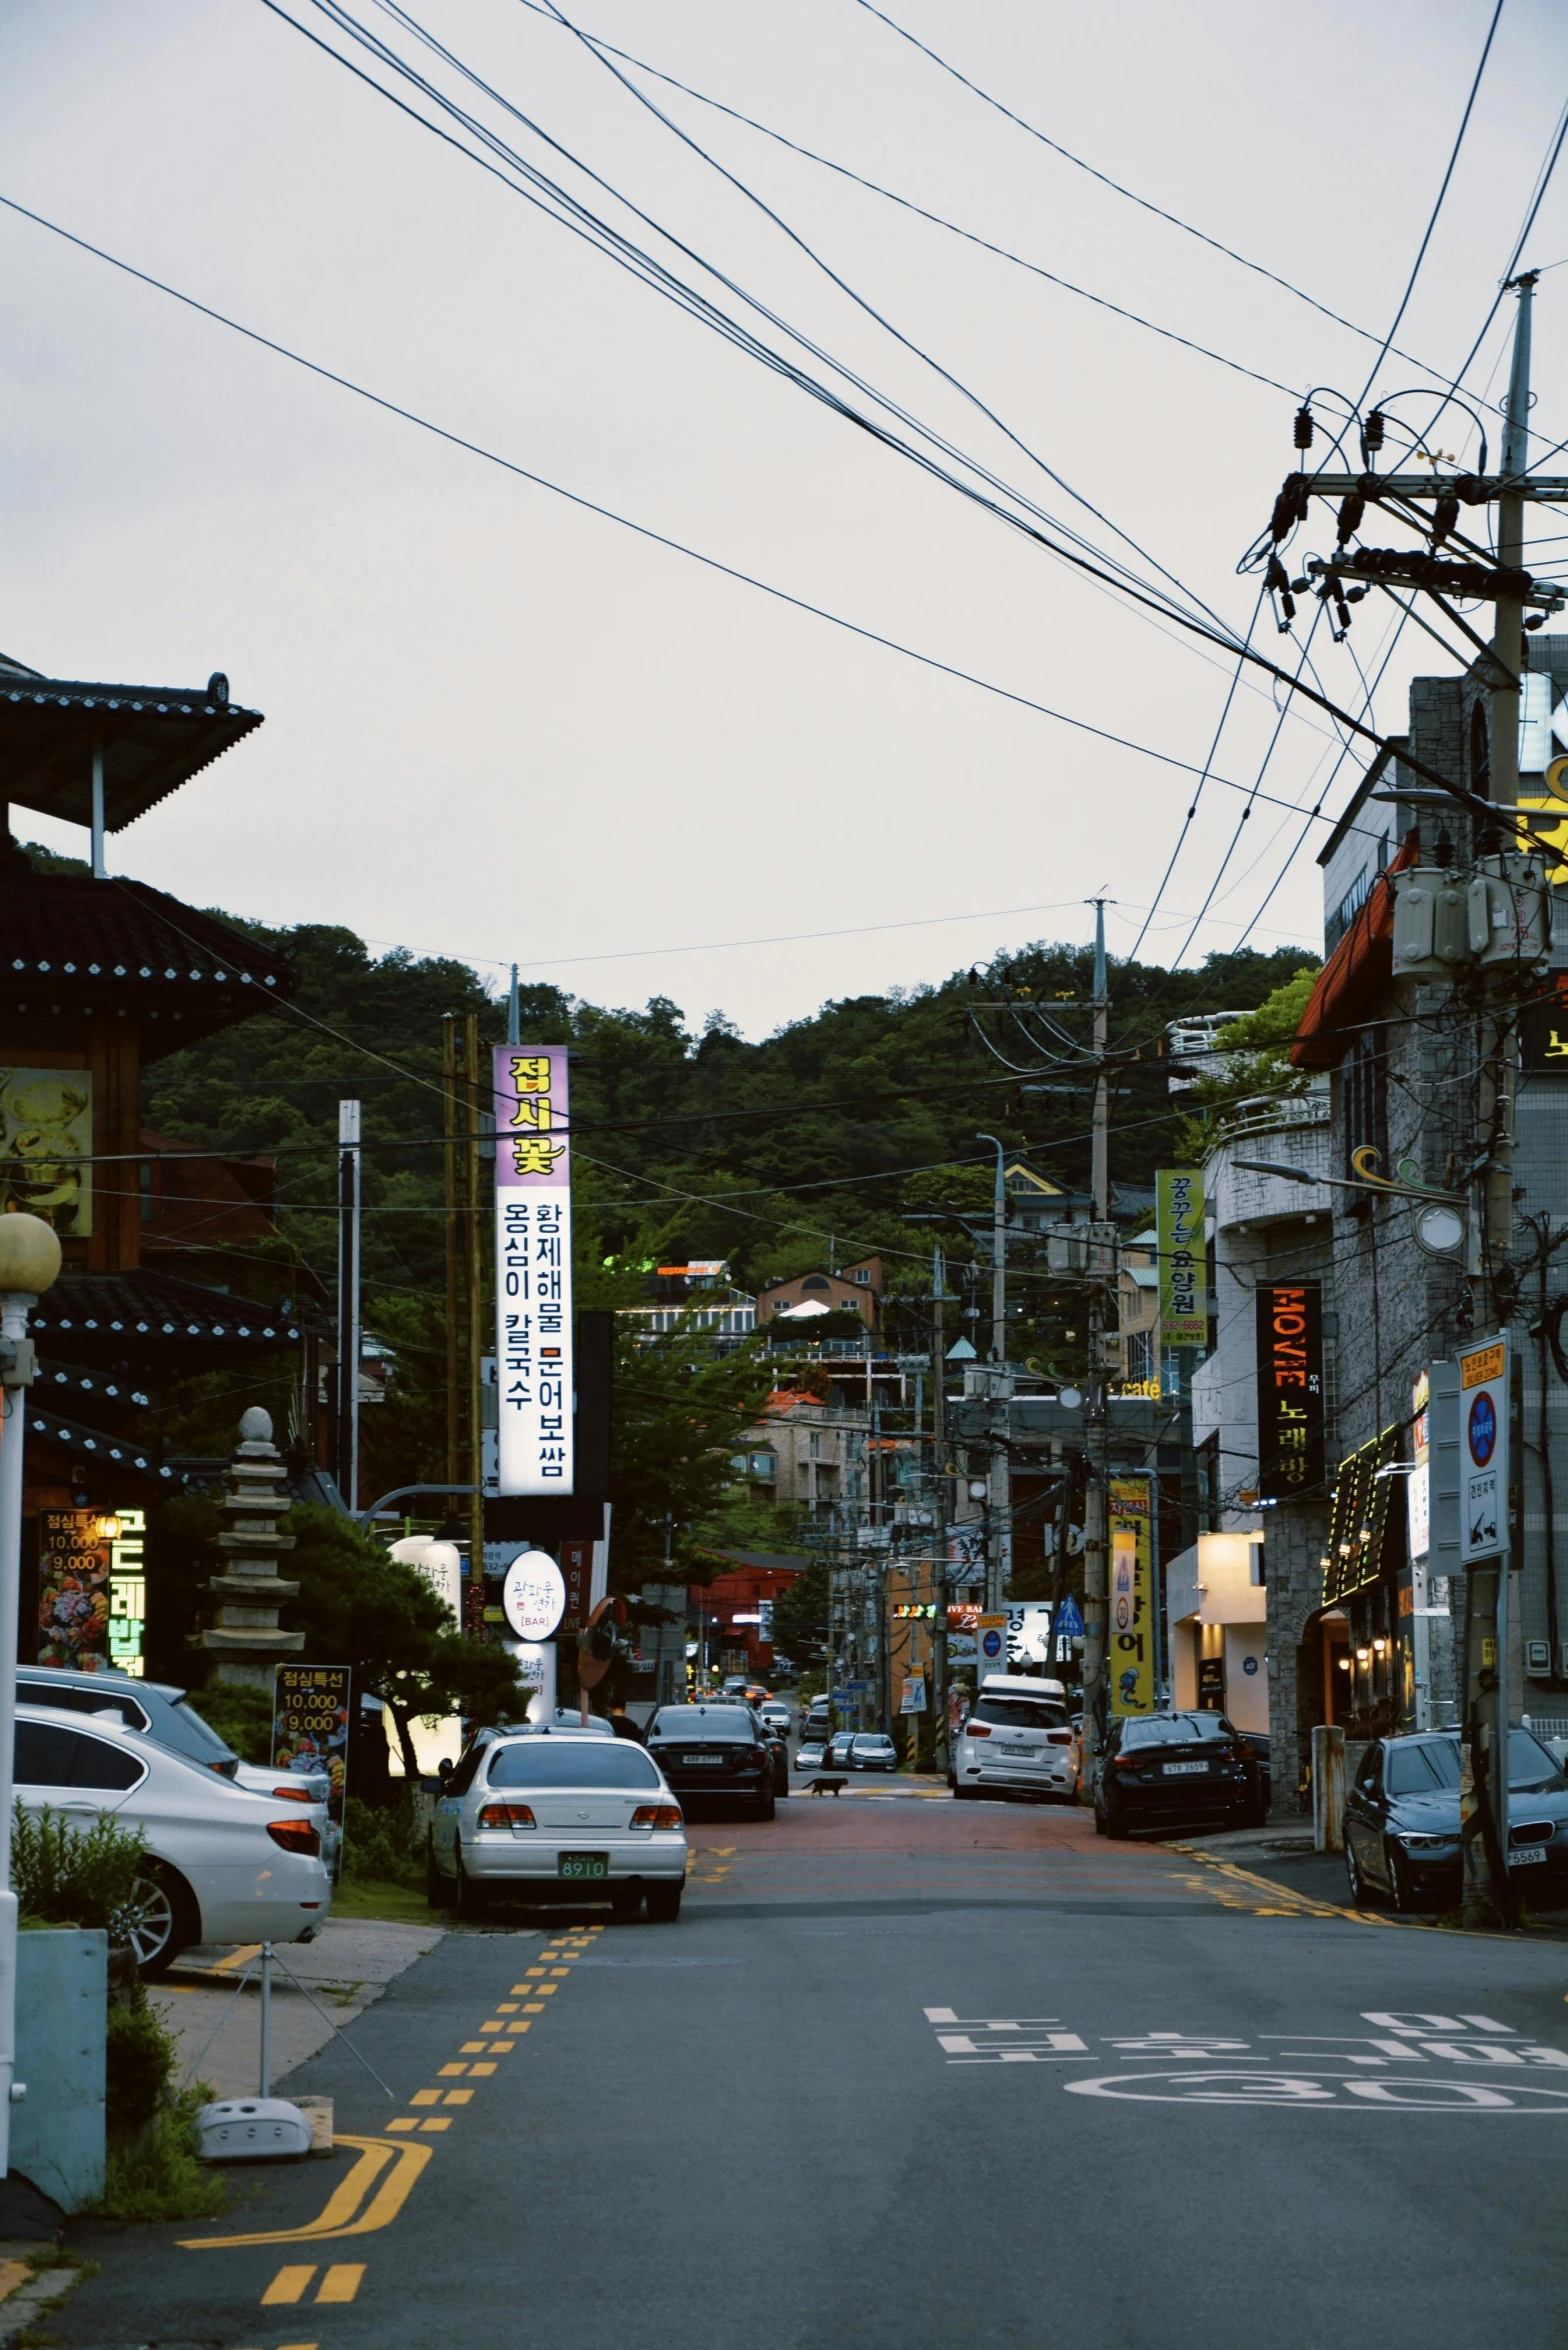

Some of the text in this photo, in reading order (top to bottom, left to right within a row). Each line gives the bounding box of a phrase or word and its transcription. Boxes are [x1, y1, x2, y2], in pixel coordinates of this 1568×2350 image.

[509, 1057, 566, 1175] 접시꽃
[1171, 1249, 1195, 1315] 요양원
[504, 1203, 533, 1411] 옹심이 칼국수
[537, 1204, 566, 1477] 황제해물 문어보쌈
[1273, 1289, 1307, 1387] MOVIE
[1276, 1399, 1308, 1484] 노래방
[1471, 1481, 1495, 1500] 견인지역
[48, 1535, 99, 1550] 10,000
[53, 1555, 96, 1571] 9,000
[283, 1671, 343, 1688] 점심특선
[284, 1694, 338, 1709] 10,000
[288, 1715, 334, 1731] 9,000
[1513, 1850, 1541, 1864] 5569
[562, 1862, 604, 1876] 8910
